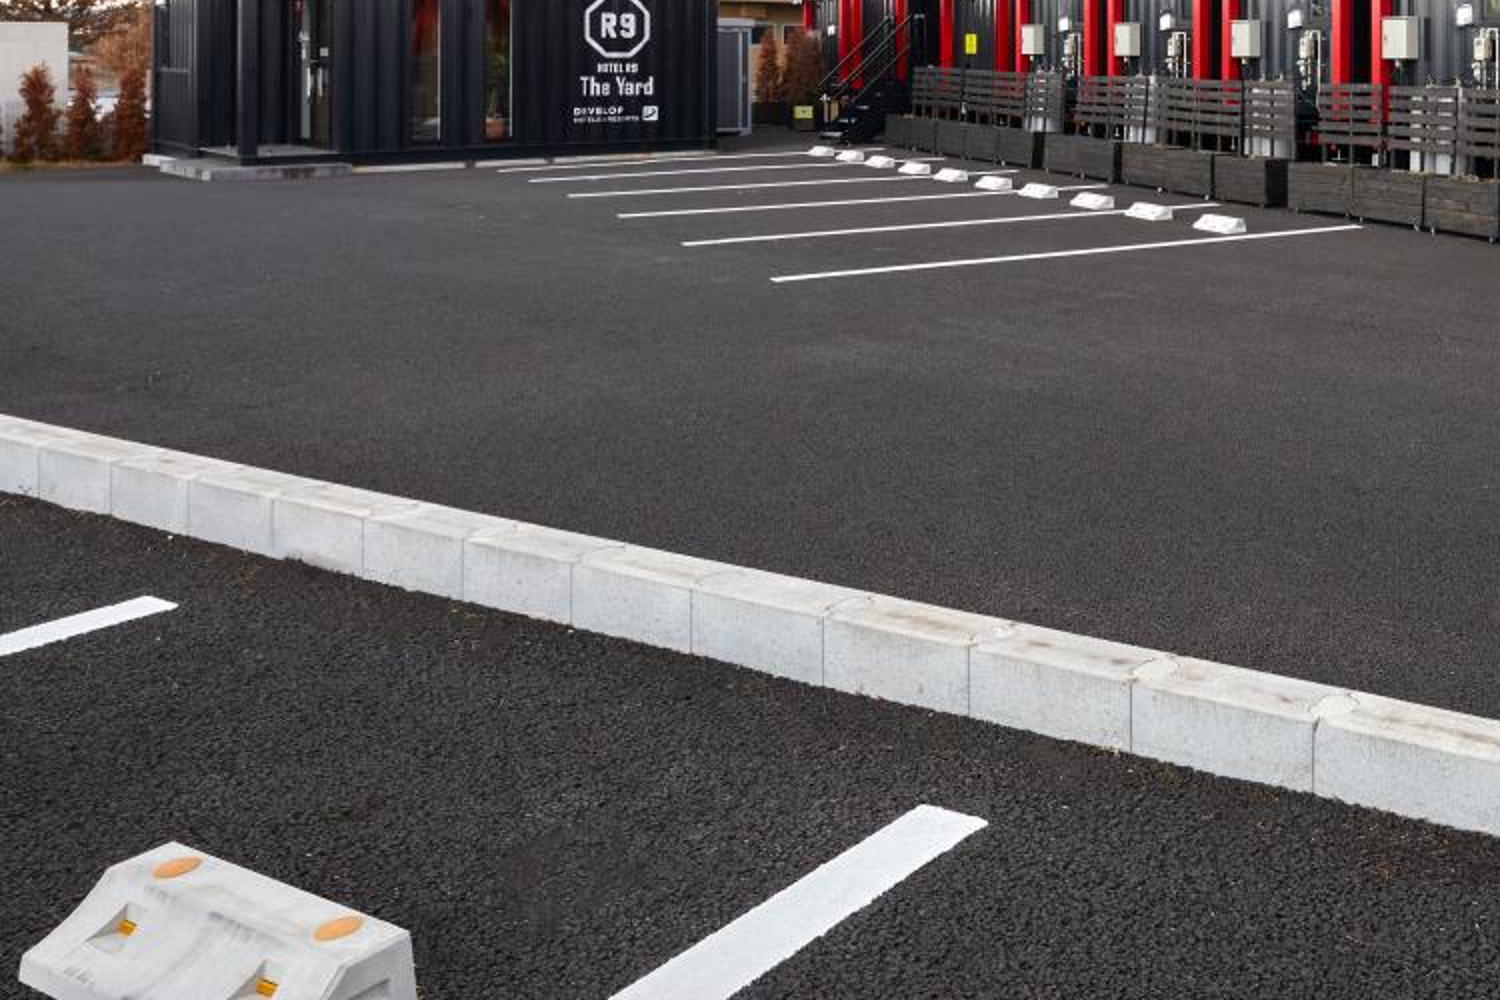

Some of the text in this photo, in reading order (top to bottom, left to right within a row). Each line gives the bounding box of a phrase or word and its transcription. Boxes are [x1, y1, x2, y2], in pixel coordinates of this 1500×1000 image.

[601, 12, 636, 38] R9
[580, 75, 654, 96] The Yard
